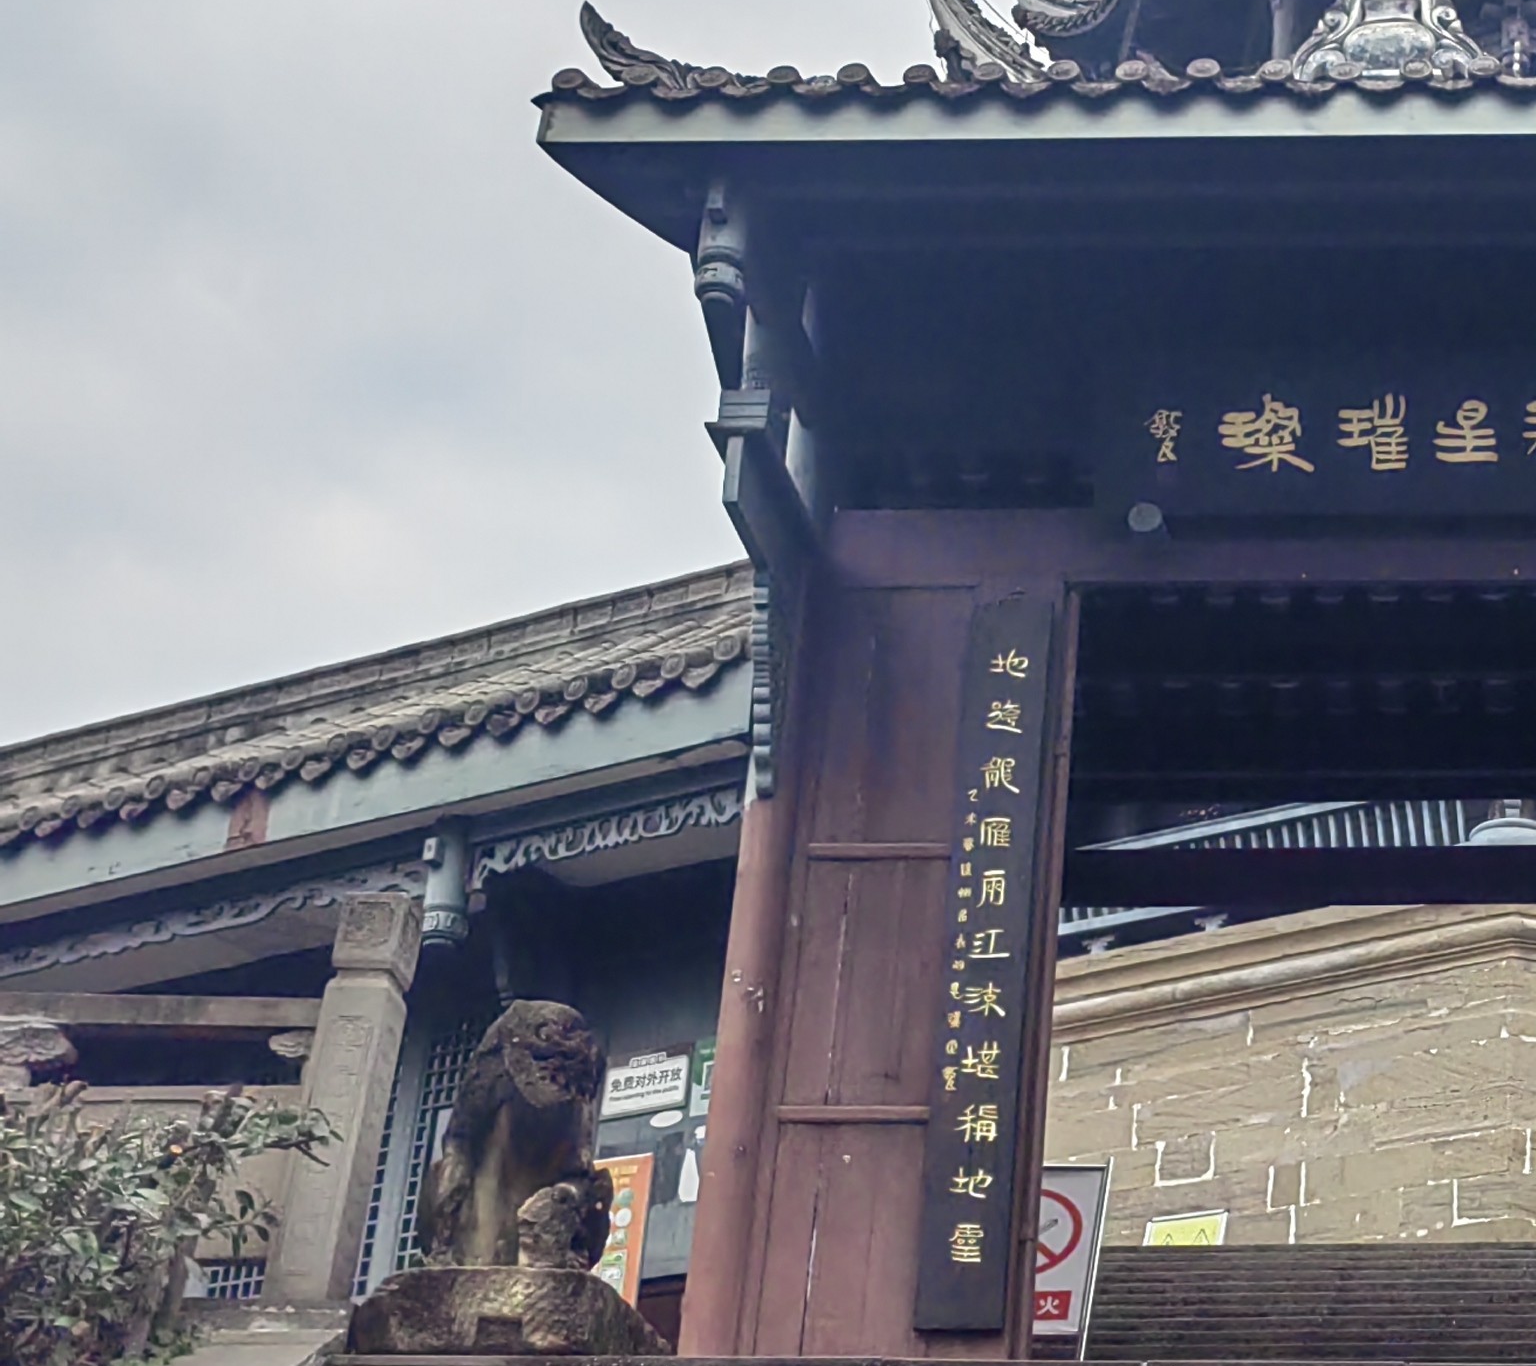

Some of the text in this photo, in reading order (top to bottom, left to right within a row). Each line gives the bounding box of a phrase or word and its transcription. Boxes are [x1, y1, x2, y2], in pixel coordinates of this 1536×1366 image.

[610, 1067, 683, 1093] 免费对外开放
